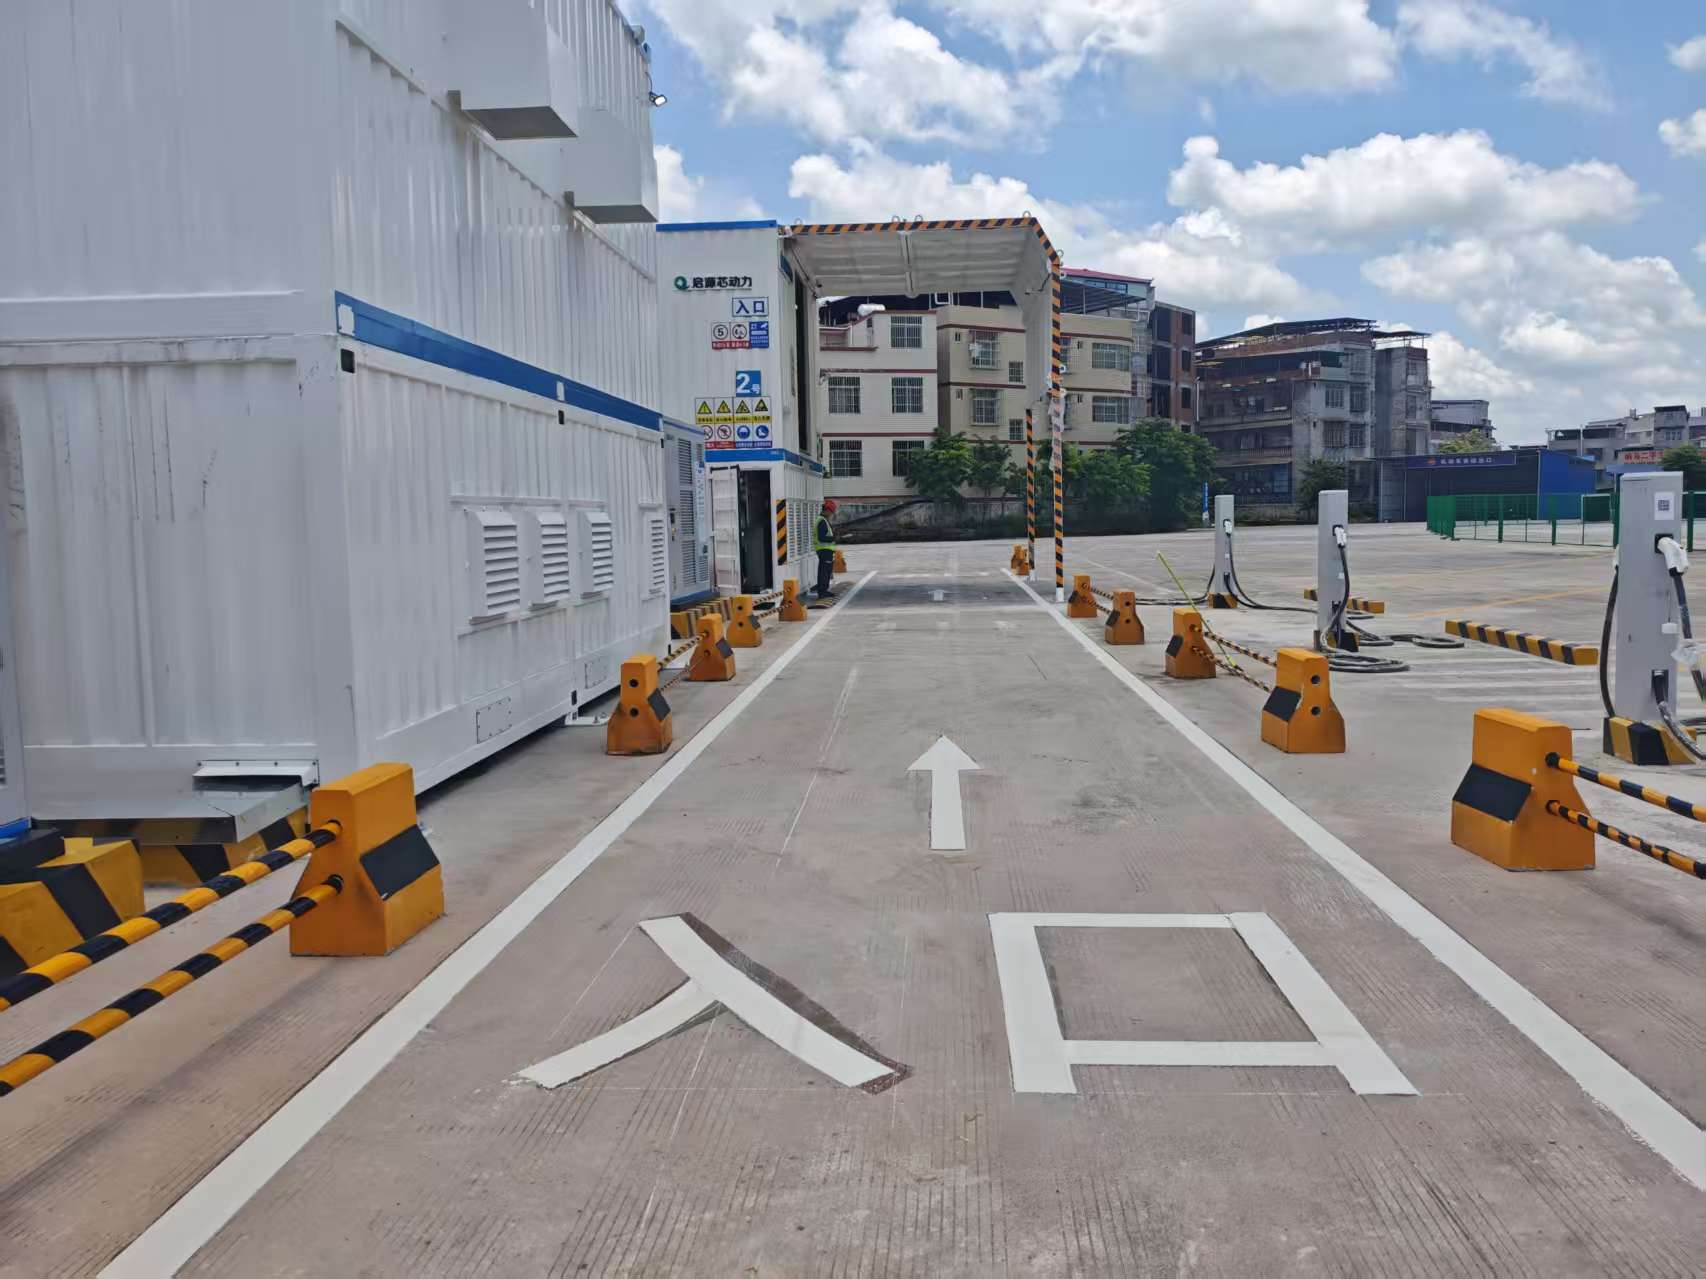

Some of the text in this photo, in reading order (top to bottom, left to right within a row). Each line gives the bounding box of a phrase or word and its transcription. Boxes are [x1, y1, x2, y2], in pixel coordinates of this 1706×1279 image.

[692, 276, 752, 289] 启源芯动力
[735, 300, 765, 314] 入口
[717, 327, 725, 337] 5
[736, 373, 760, 394] 2号
[512, 912, 1419, 1097] 入口
